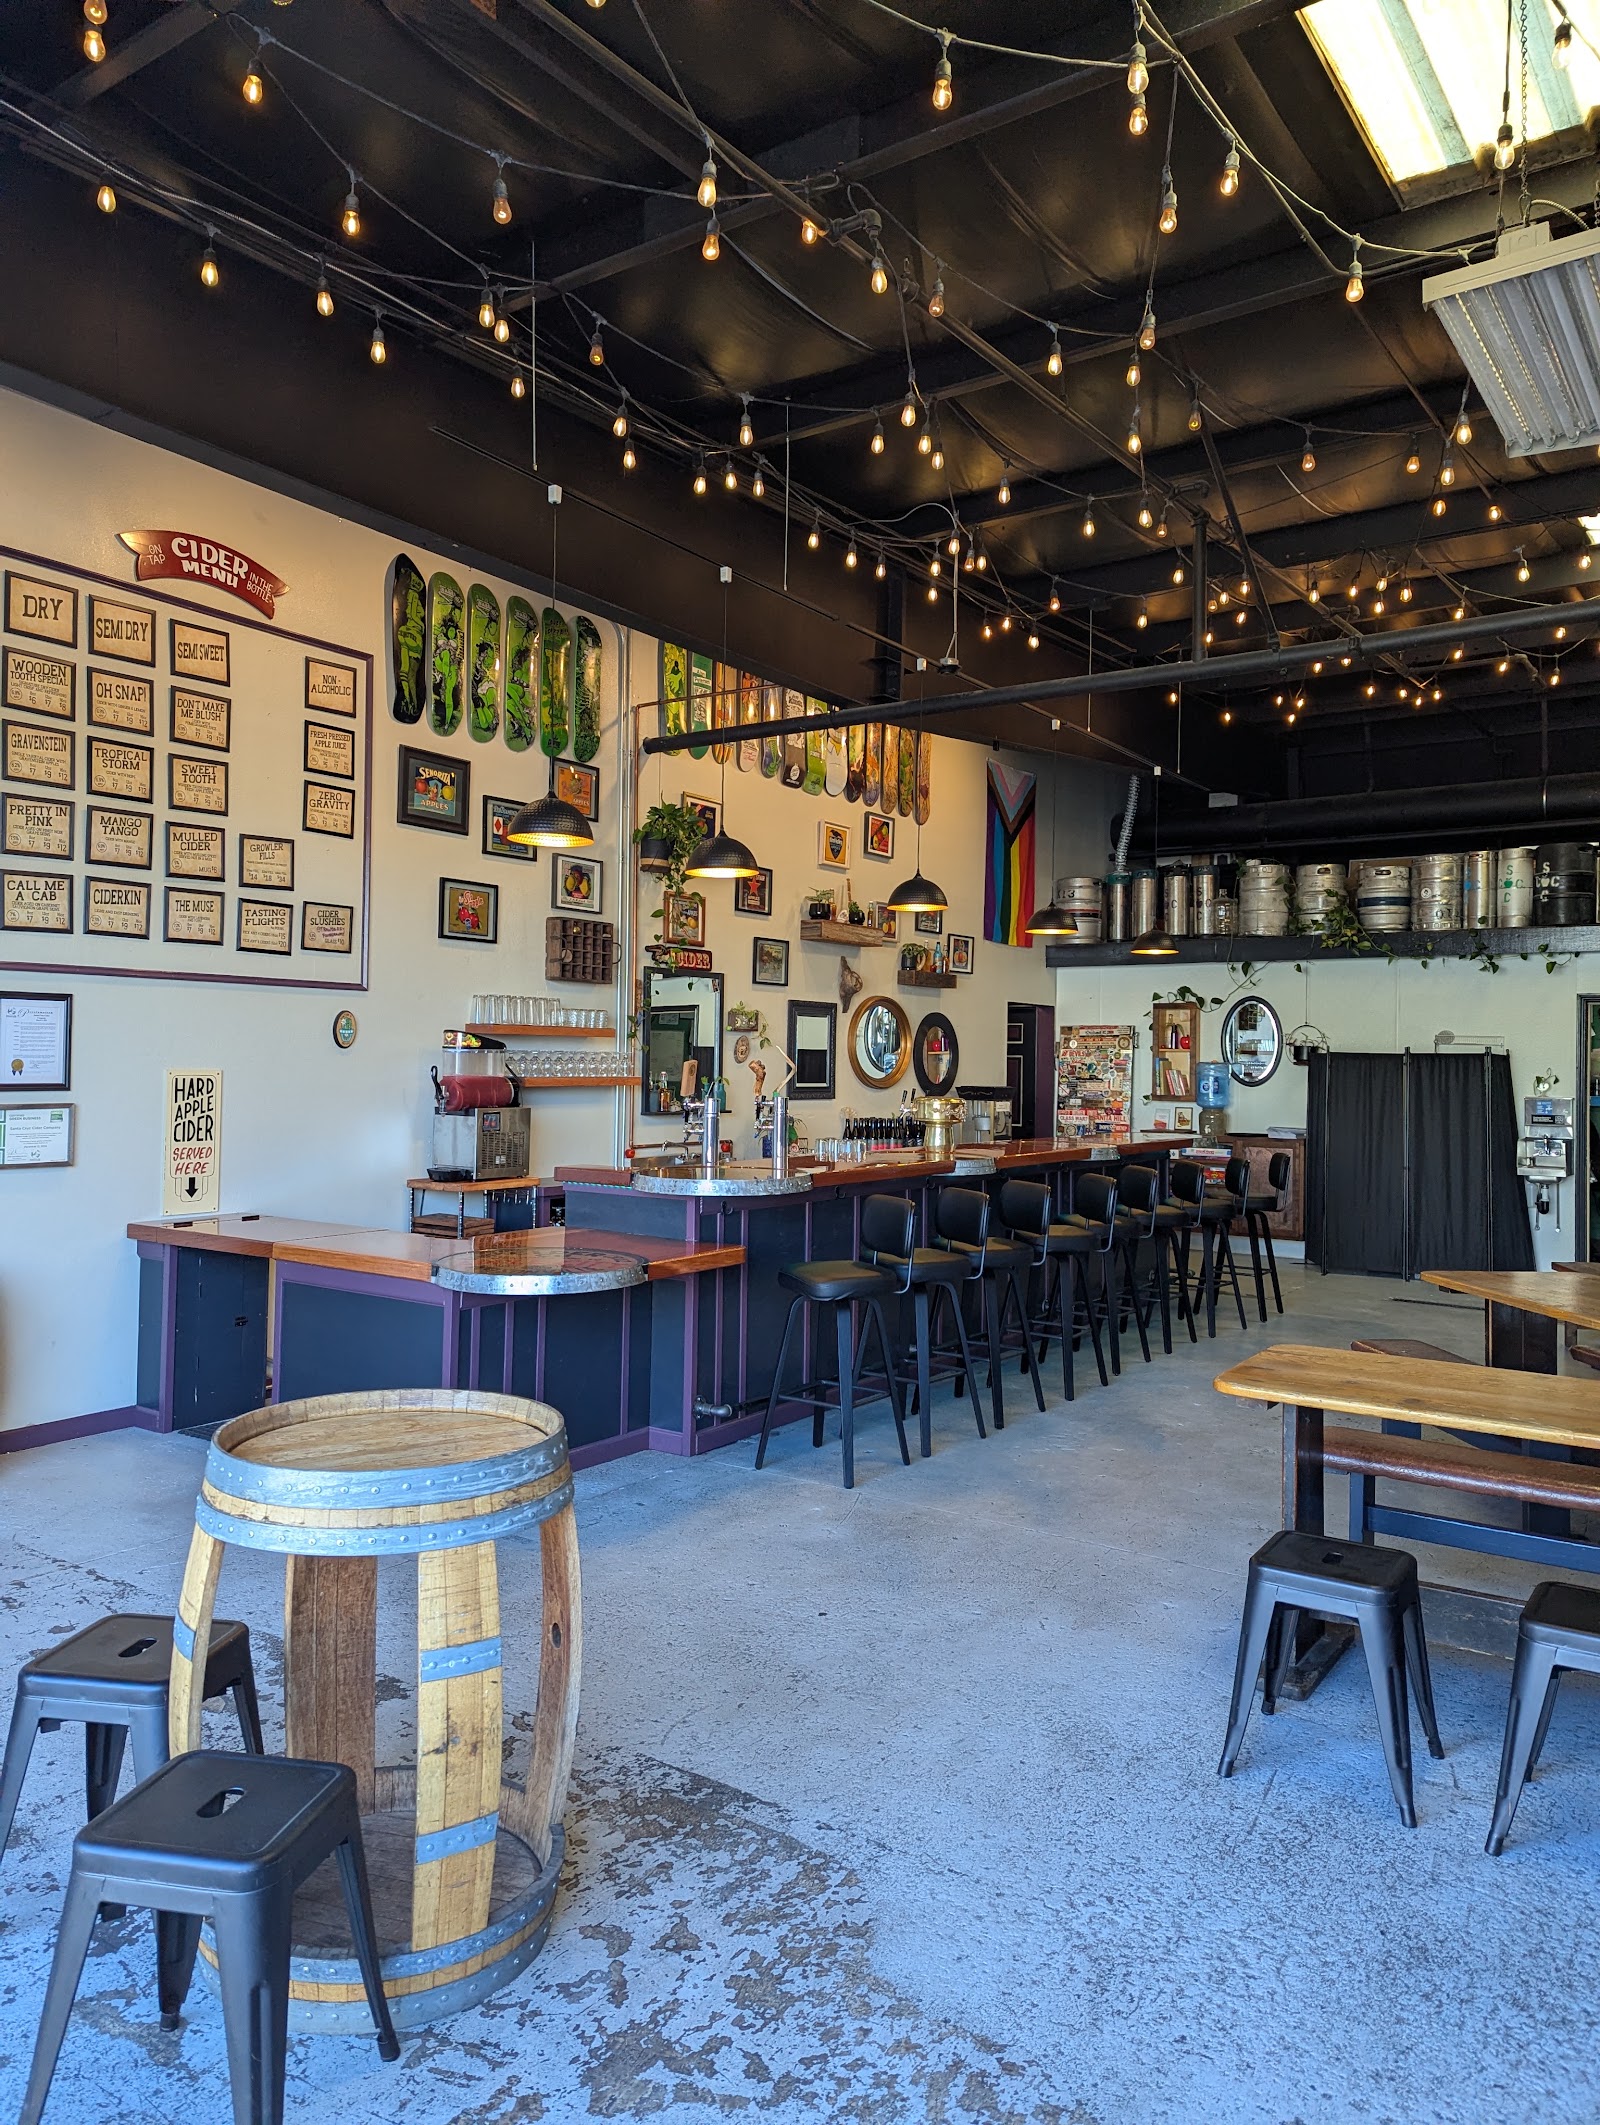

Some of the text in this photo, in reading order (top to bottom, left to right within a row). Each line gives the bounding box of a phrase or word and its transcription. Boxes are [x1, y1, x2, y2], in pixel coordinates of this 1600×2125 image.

[148, 543, 163, 555] ON
[146, 554, 166, 566] TAP
[171, 537, 249, 580] CIDER
[181, 559, 239, 589] MENU
[249, 571, 274, 594] IN THE
[246, 580, 271, 603] BOTTLE
[22, 594, 63, 620] DRY
[95, 618, 148, 642] SEMI DRY
[177, 641, 225, 662] SEMI SWEET
[12, 658, 67, 678] WOODEN
[10, 670, 36, 682] TOOTH
[37, 674, 69, 686] SPECIAL
[96, 682, 146, 702] OH SNAP!
[310, 684, 351, 696] ALCOHOLIC
[28, 695, 37, 705] $6
[44, 699, 51, 708] $7
[202, 701, 225, 713] MAKE
[180, 708, 222, 722] ME BLUSH
[310, 730, 351, 742] FRESH PRESSED
[11, 733, 67, 752] GRAVENSTEIN
[314, 740, 347, 750] APPLE JUICE
[94, 747, 147, 762] TROPICAL
[102, 759, 140, 771] STORM
[181, 764, 217, 775] SWEET
[29, 767, 36, 776] $7
[44, 770, 51, 779] $9
[58, 772, 68, 782] $12
[419, 767, 451, 786] SENORITA
[181, 774, 217, 785] TOOTH
[112, 782, 119, 790] $7
[138, 786, 147, 795] $12
[319, 790, 342, 801] ZERO
[9, 804, 68, 817] PRETTY IN
[309, 799, 350, 811] GRAVITY
[420, 800, 449, 811] APPLES
[24, 816, 53, 828] PINK
[99, 816, 142, 828] MANGO
[102, 826, 139, 837] TANGO
[172, 832, 218, 842] MULLED
[28, 840, 35, 848] $7
[43, 841, 51, 850] $9
[57, 843, 67, 852] $12
[180, 842, 211, 851] CIDER
[249, 843, 284, 853] GROWLER
[135, 850, 144, 858] $12
[259, 851, 276, 860] FILLS
[1506, 865, 1514, 876] S
[7, 880, 65, 891] CALL ME
[15, 891, 57, 901] A CAB
[94, 889, 142, 906] CIDERKIN
[175, 900, 215, 913] THE MUSE
[244, 909, 286, 917] TASTING
[317, 910, 340, 918] CIDER
[27, 915, 34, 923] $7
[42, 916, 49, 925] $9
[56, 917, 66, 925] $12
[244, 918, 286, 926] FLIGHTS
[310, 918, 346, 926] SLUSHIES
[108, 921, 114, 929] $7
[121, 922, 129, 930] $9
[134, 923, 143, 932] $12
[676, 951, 710, 969] CIDER
[174, 1078, 214, 1104] HARD
[174, 1095, 214, 1122] APPLE
[173, 1114, 214, 1143] CIDER
[173, 1146, 213, 1162] SERVED
[175, 1162, 210, 1176] HERE
